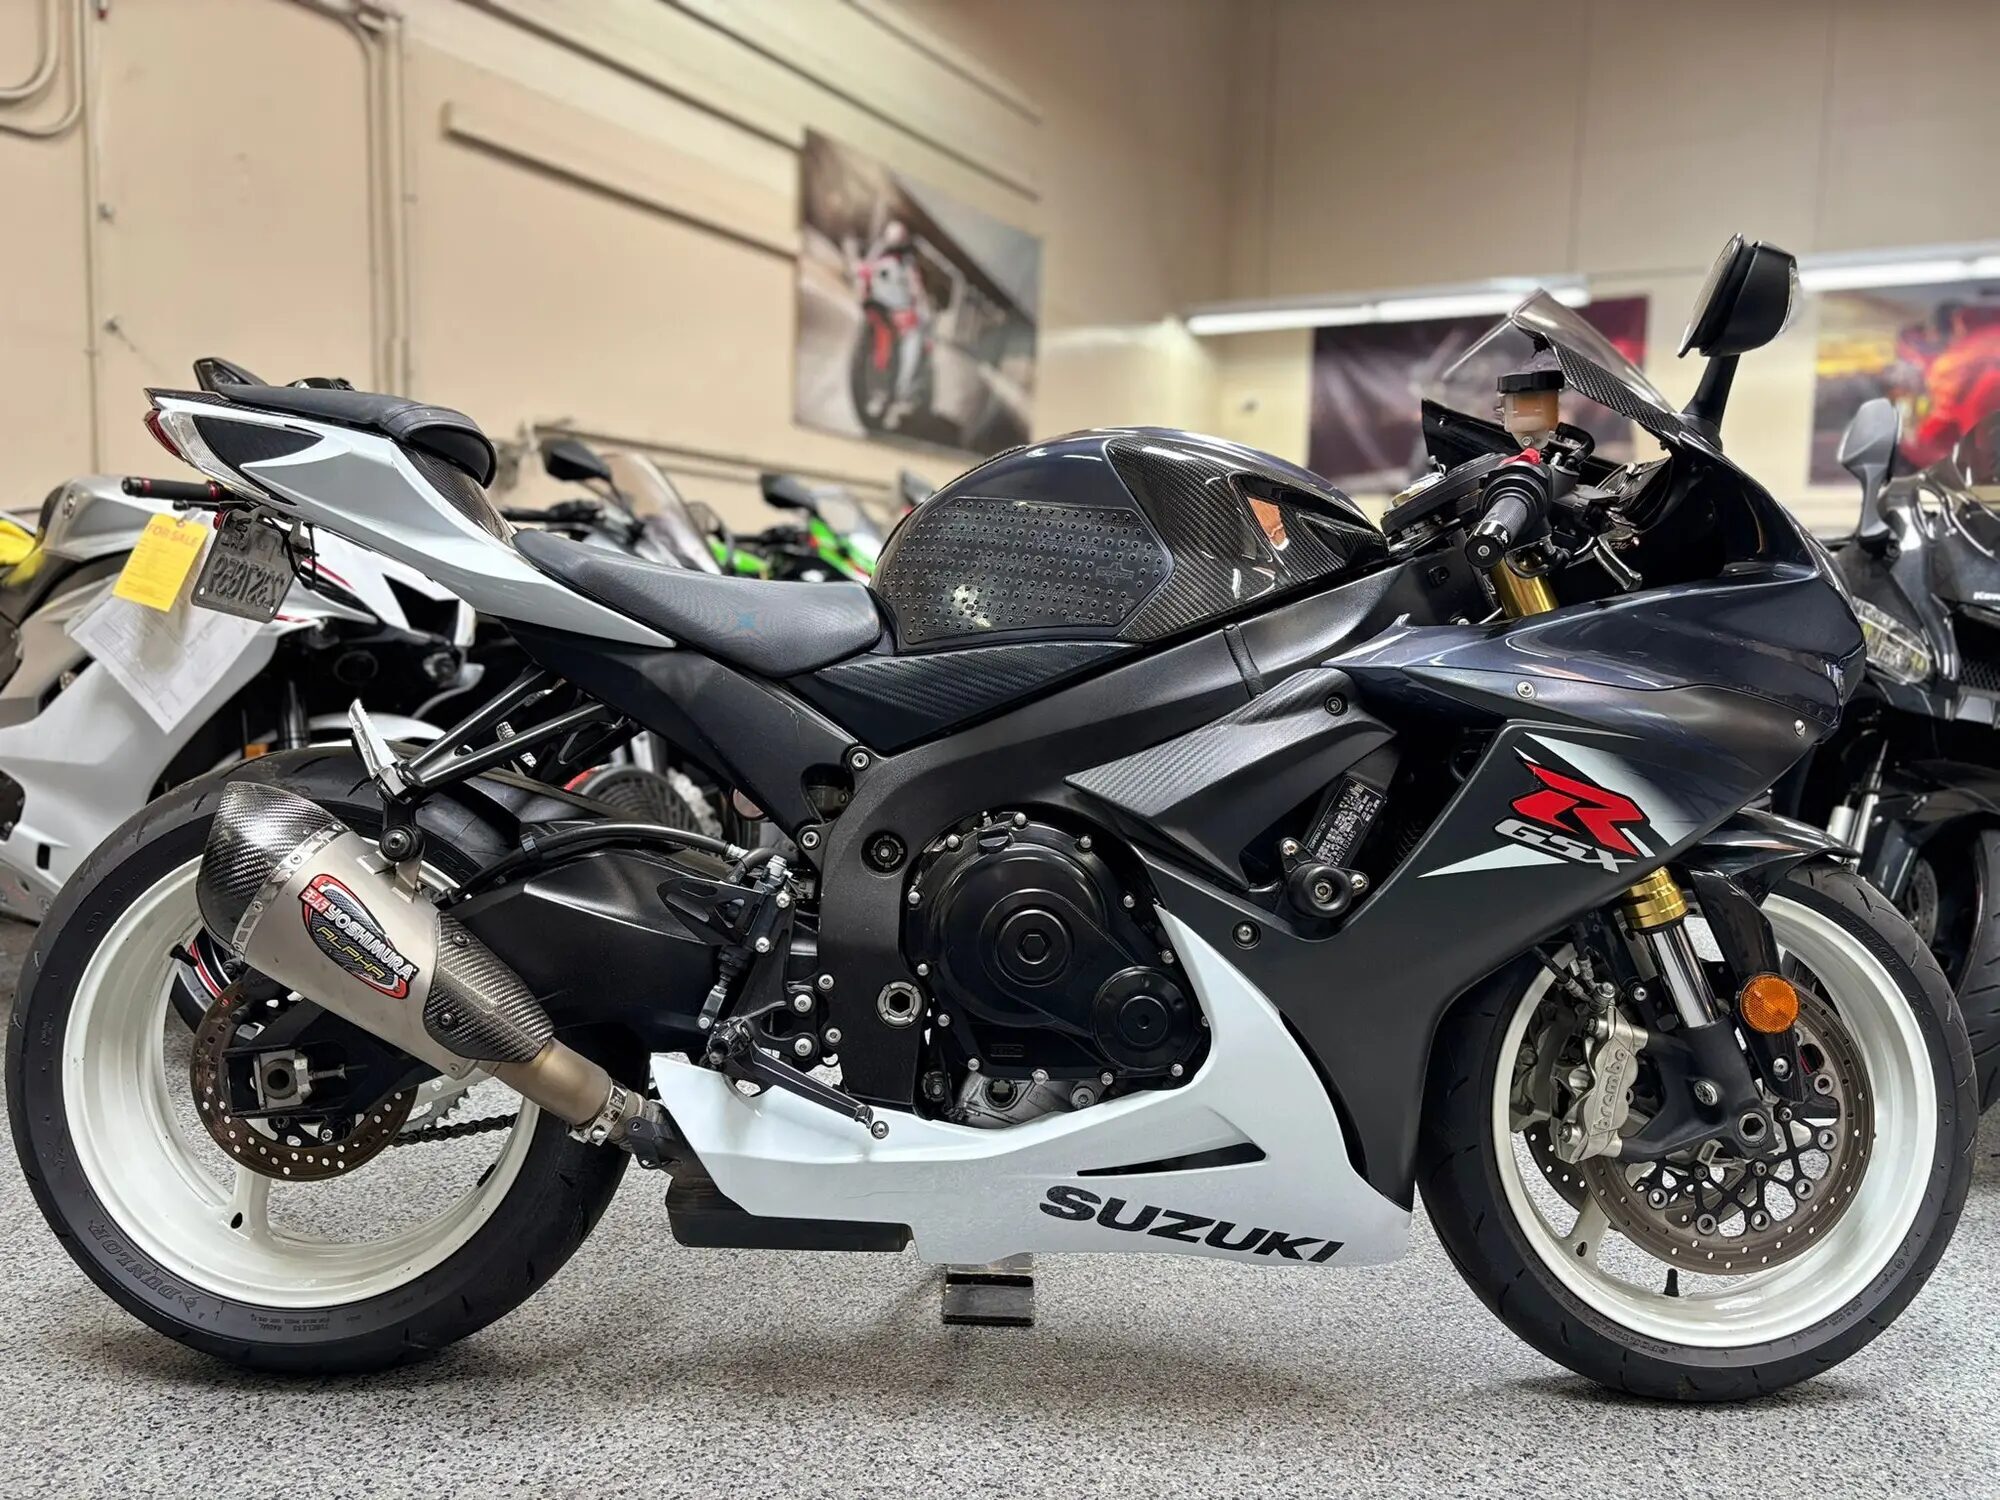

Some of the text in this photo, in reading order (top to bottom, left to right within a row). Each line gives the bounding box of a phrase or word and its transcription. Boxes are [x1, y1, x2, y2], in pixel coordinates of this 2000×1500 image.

[146, 523, 200, 548] FOR SALE
[316, 926, 386, 980] ALPHA
[323, 903, 415, 981] YOSHIMURA
[1593, 1049, 1627, 1130] brembo
[87, 1219, 181, 1300] DUNLOP
[1039, 1185, 1345, 1263] SUZUKI
